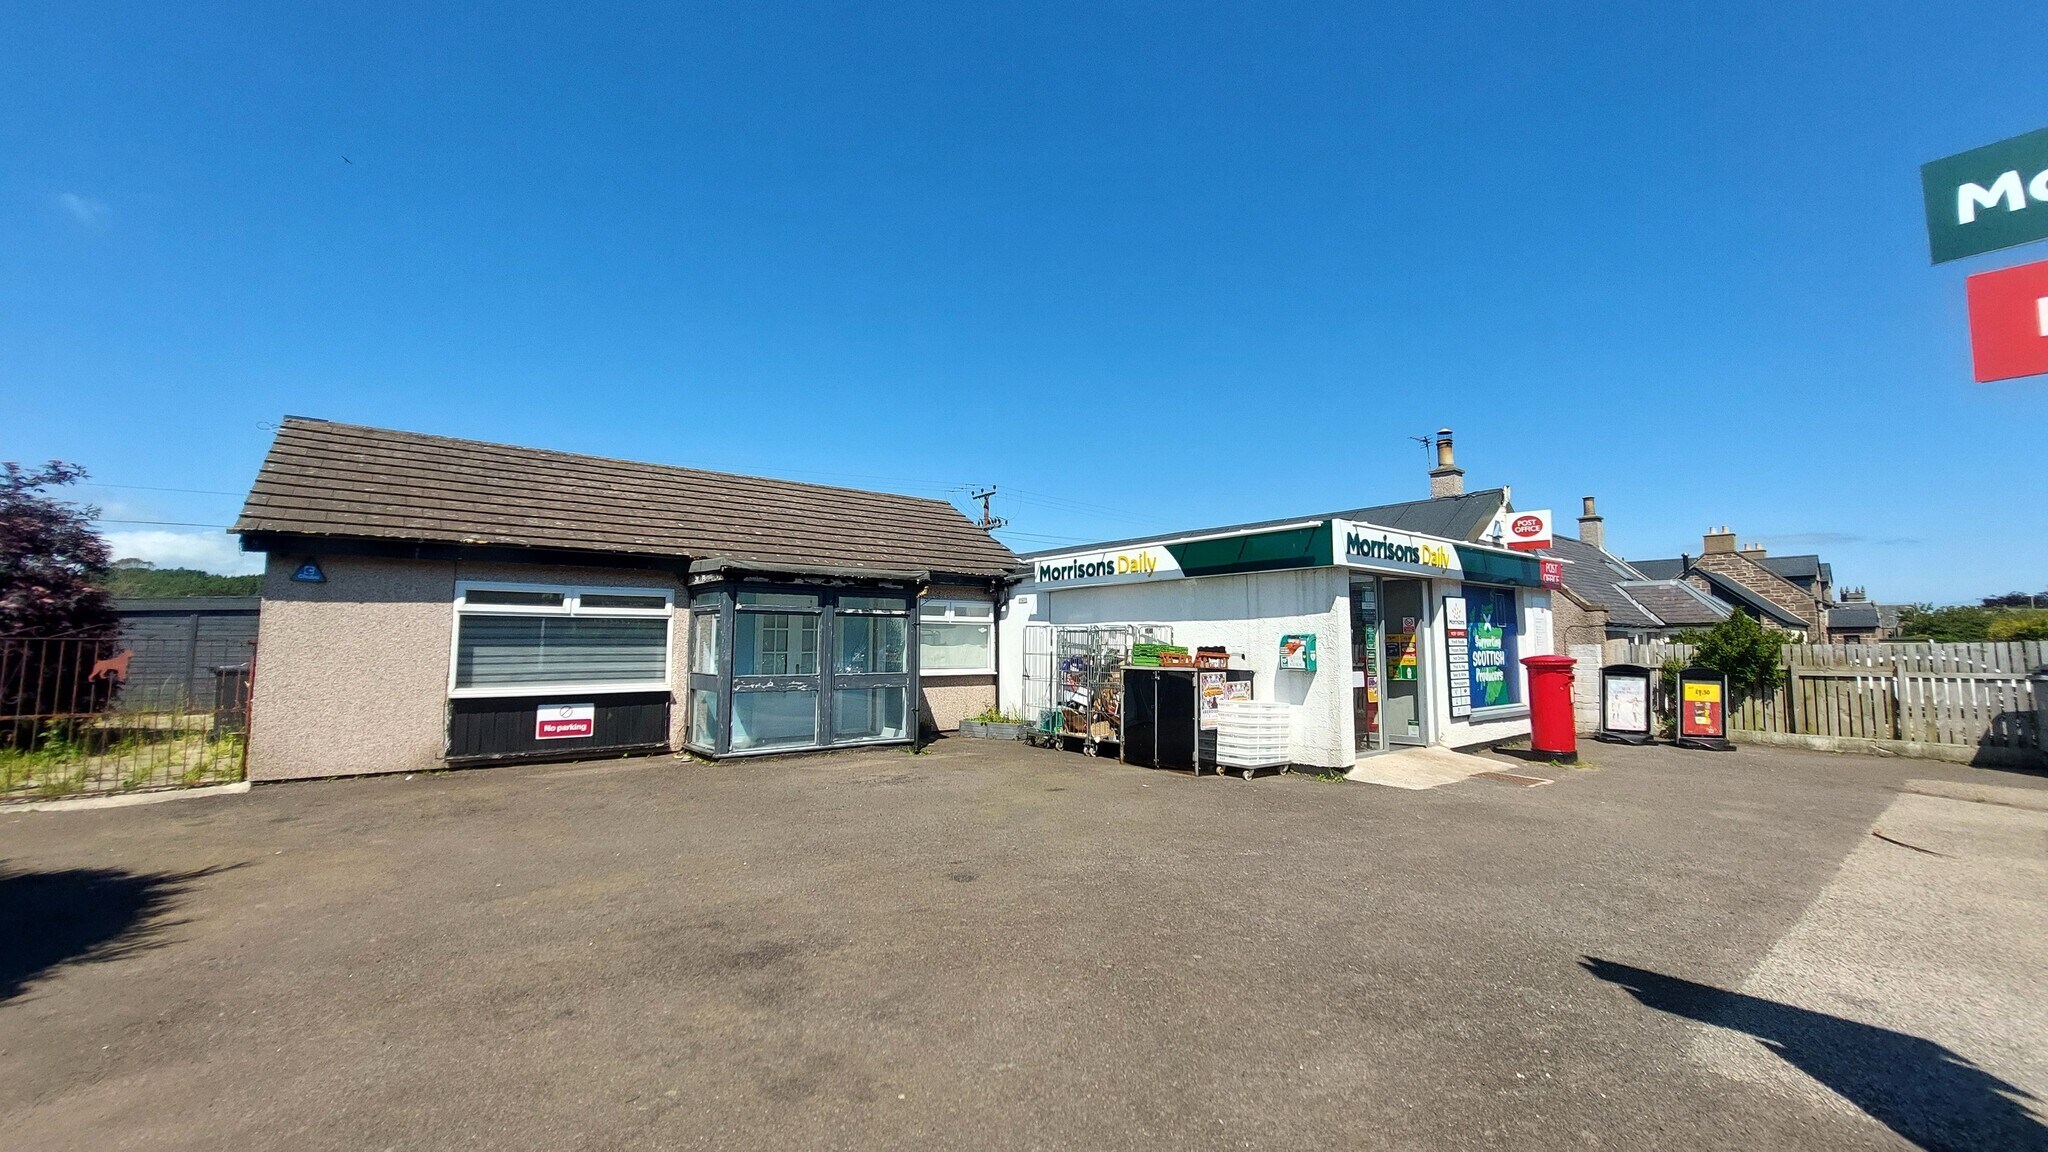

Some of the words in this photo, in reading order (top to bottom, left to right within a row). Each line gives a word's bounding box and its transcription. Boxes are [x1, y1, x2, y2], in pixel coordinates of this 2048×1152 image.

[1514, 525, 1540, 533] OFFICE
[1517, 519, 1537, 527] POST
[1346, 531, 1420, 564] Morrisons
[1421, 544, 1450, 574] Daily
[1039, 558, 1115, 582] Morrisons
[1117, 551, 1157, 578] Daily
[1545, 562, 1558, 573] POST
[1472, 650, 1505, 667] SCOTTISH
[1475, 667, 1504, 683] Producers
[543, 724, 556, 732] No
[556, 723, 587, 732] parking
